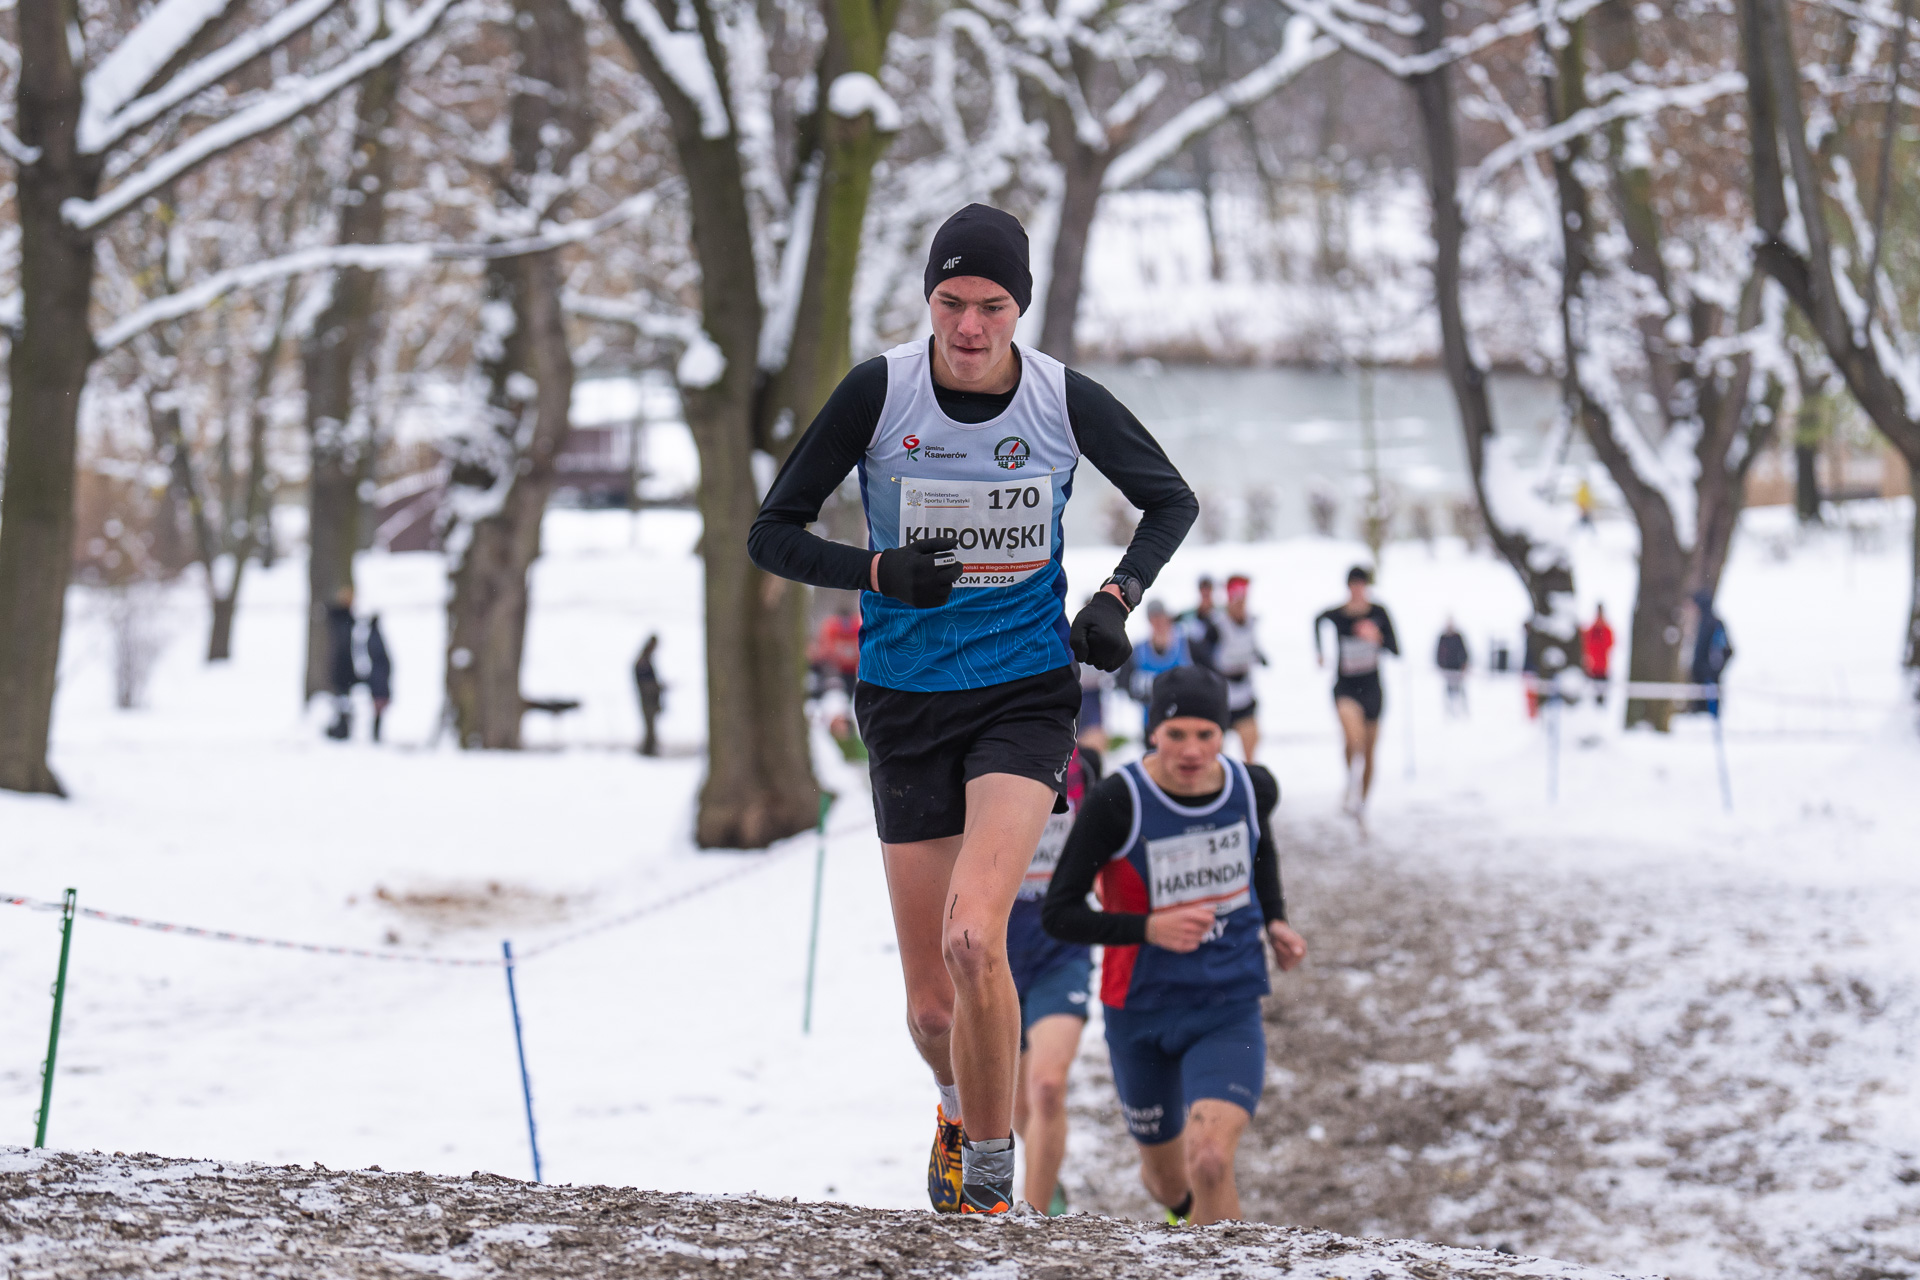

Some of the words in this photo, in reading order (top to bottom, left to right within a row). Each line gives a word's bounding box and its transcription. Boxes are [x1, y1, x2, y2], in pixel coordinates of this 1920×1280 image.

[924, 451, 967, 459] Ksawerów
[988, 486, 1040, 510] 170
[983, 575, 1015, 584] 2024
[1207, 831, 1241, 854] 143
[1156, 860, 1247, 897] HARENDA
